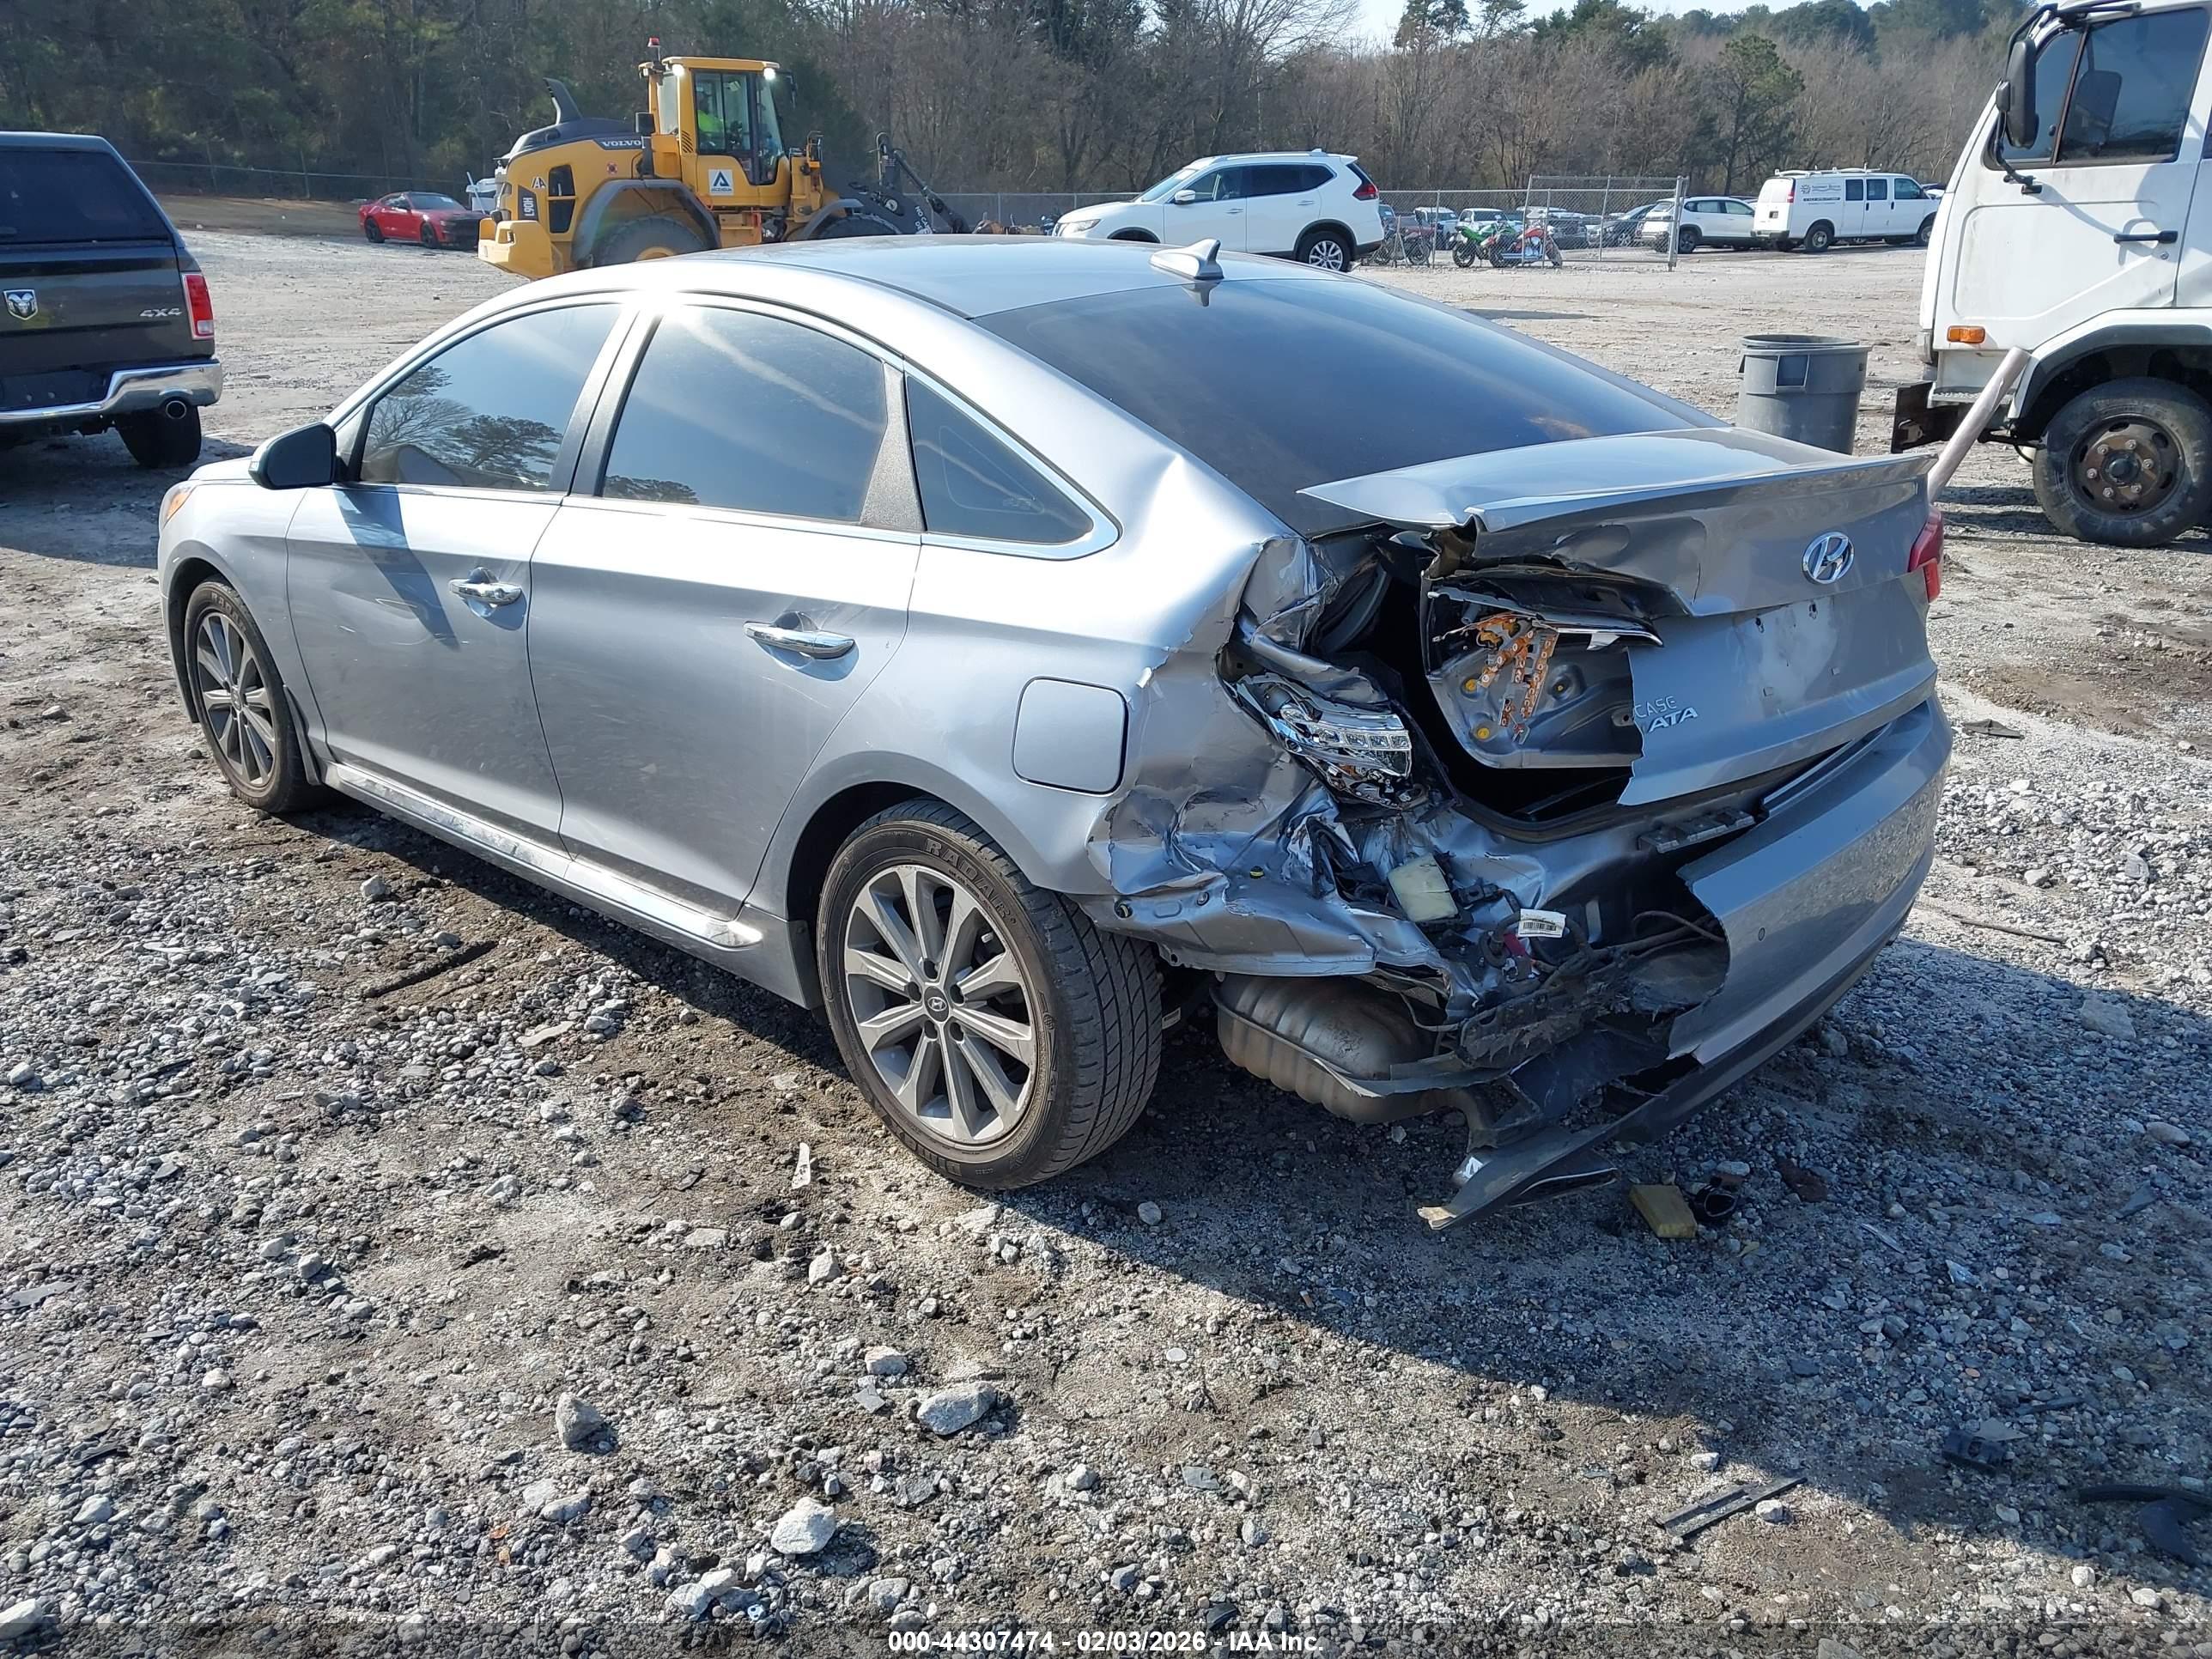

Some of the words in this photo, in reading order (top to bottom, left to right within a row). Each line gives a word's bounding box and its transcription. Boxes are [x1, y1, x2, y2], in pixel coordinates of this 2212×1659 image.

[522, 198, 535, 216] L90H
[1641, 707, 1698, 734] ATA
[926, 838, 1012, 920] RADAR
